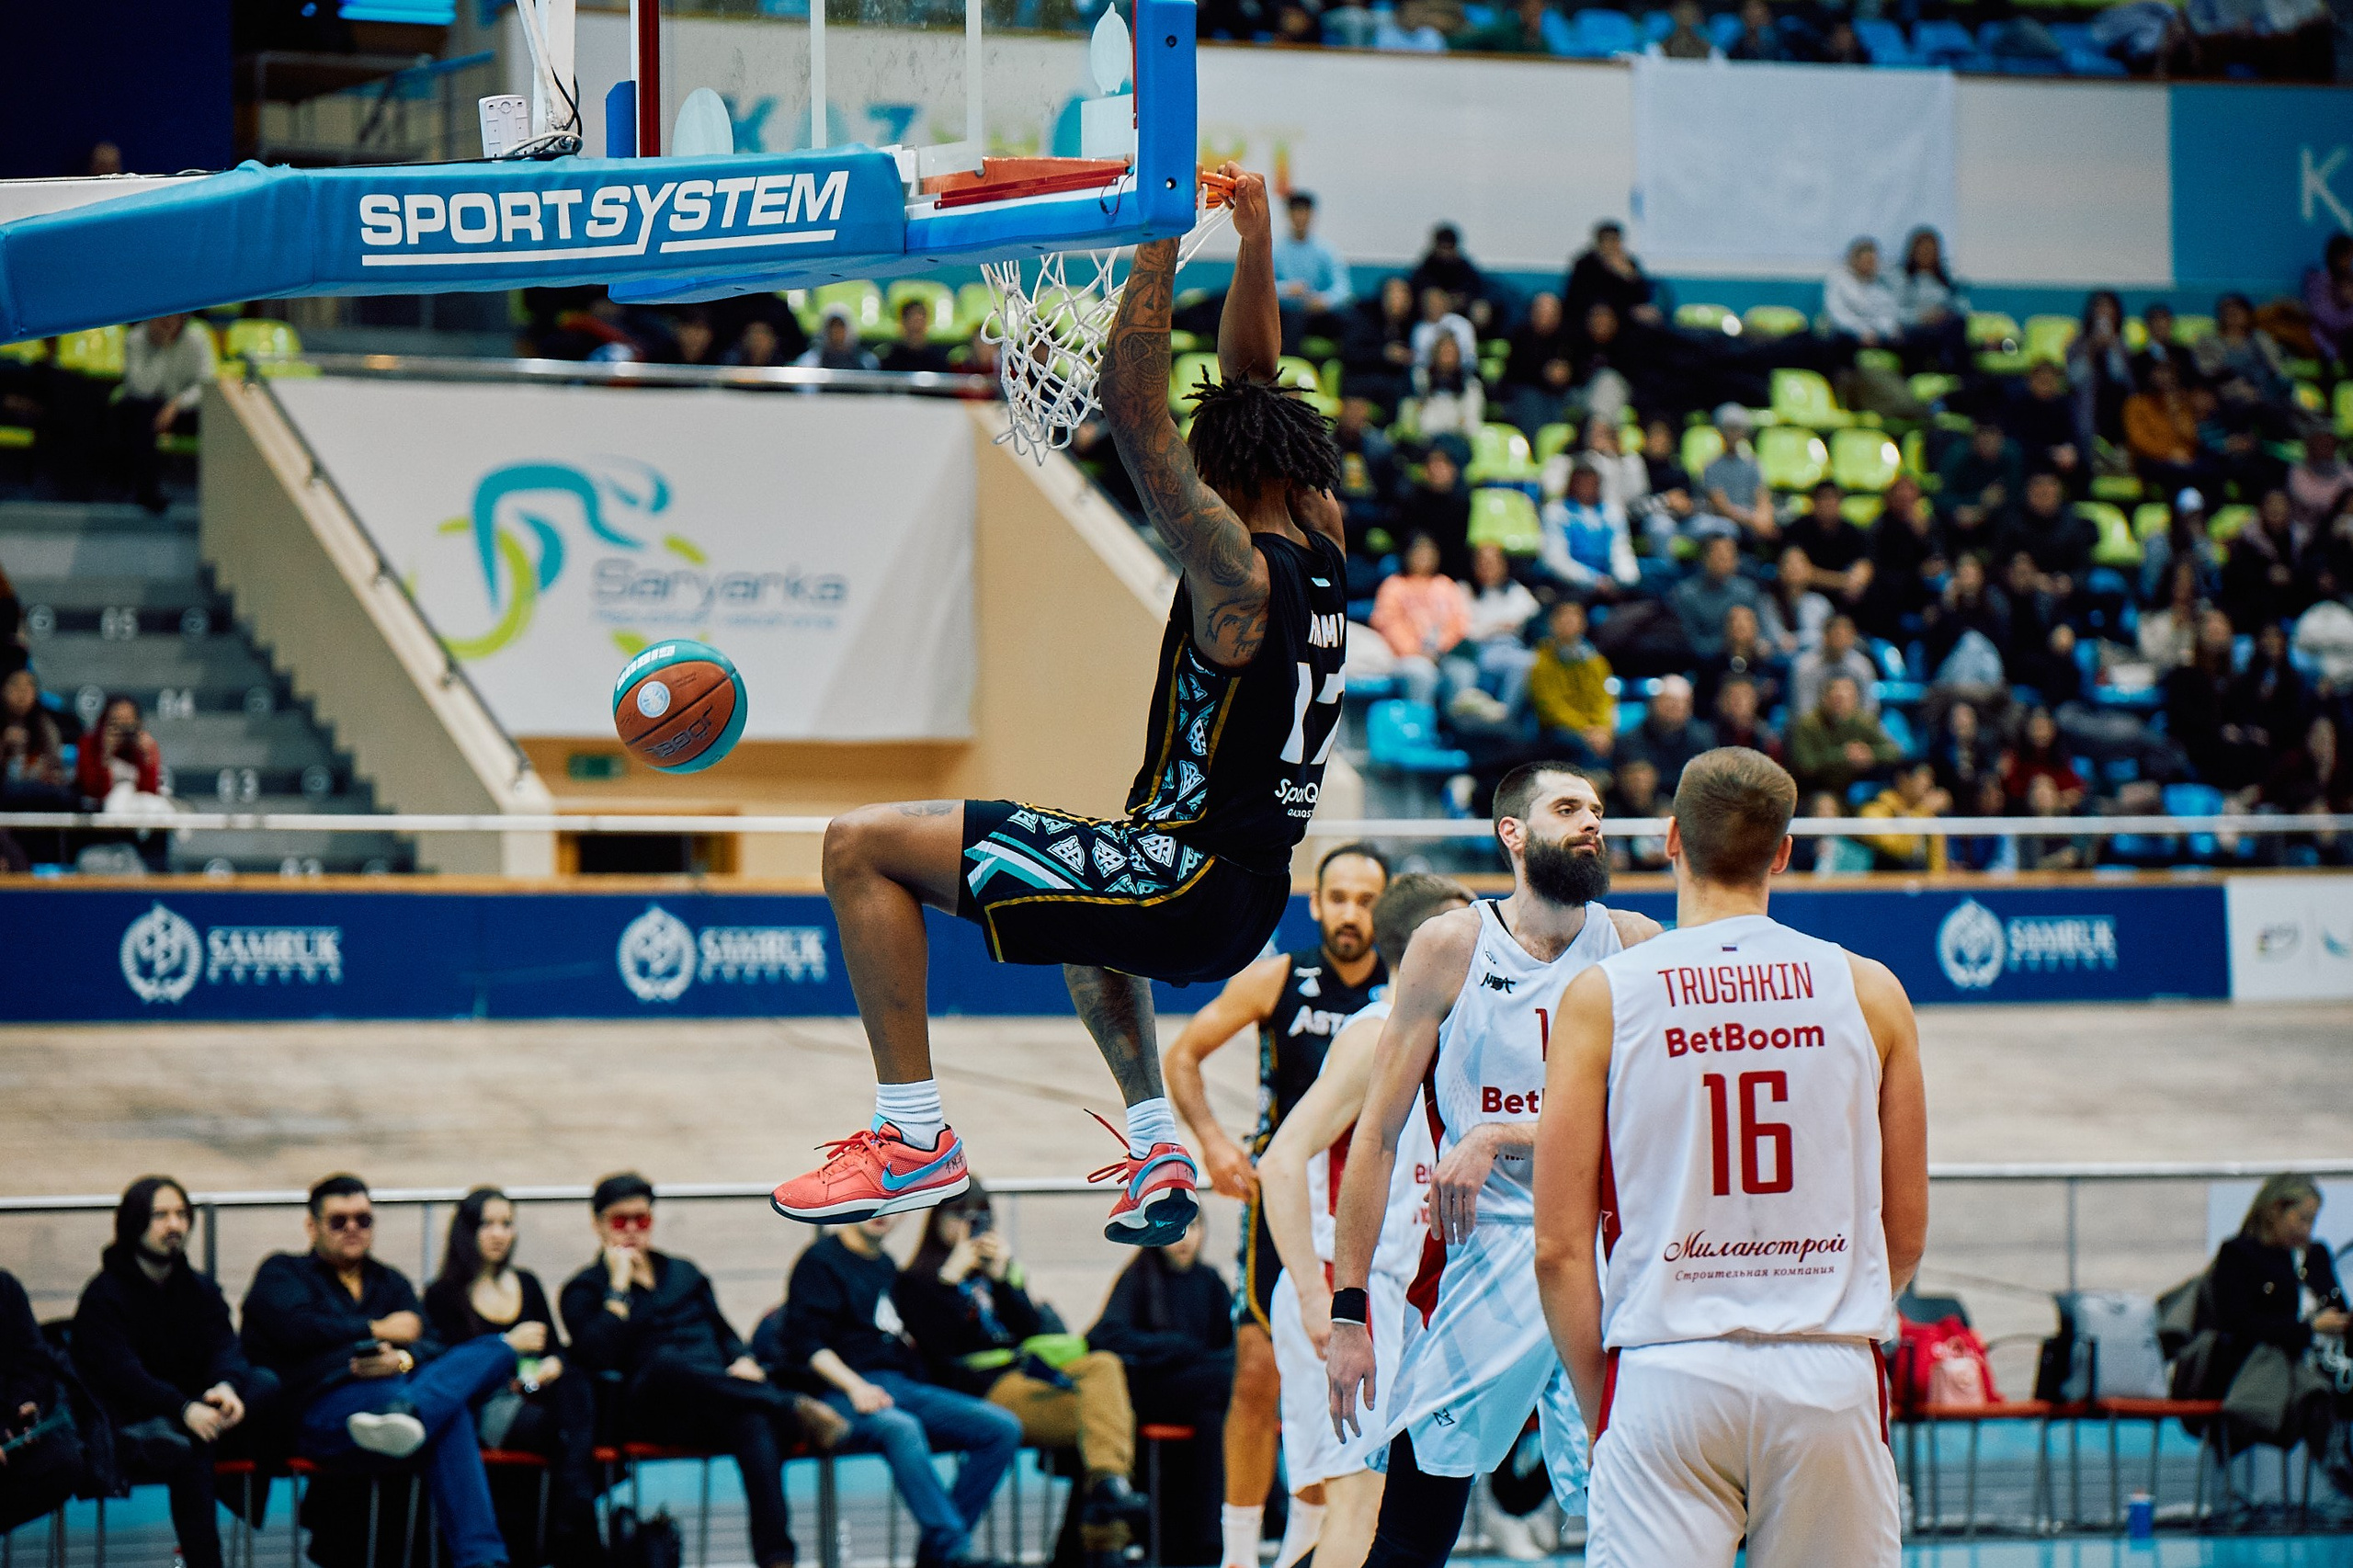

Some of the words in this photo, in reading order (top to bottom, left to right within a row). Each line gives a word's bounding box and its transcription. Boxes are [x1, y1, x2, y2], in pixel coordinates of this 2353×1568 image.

[1657, 962, 1813, 1007] TRUSHKIN
[1665, 1022, 1824, 1058] BetBoom
[1482, 1086, 1545, 1113] Bet
[1703, 1070, 1793, 1196] 16
[1664, 1229, 1847, 1263] Миланстрой
[1676, 1267, 1768, 1283] Строительная
[1773, 1265, 1835, 1277] компания
